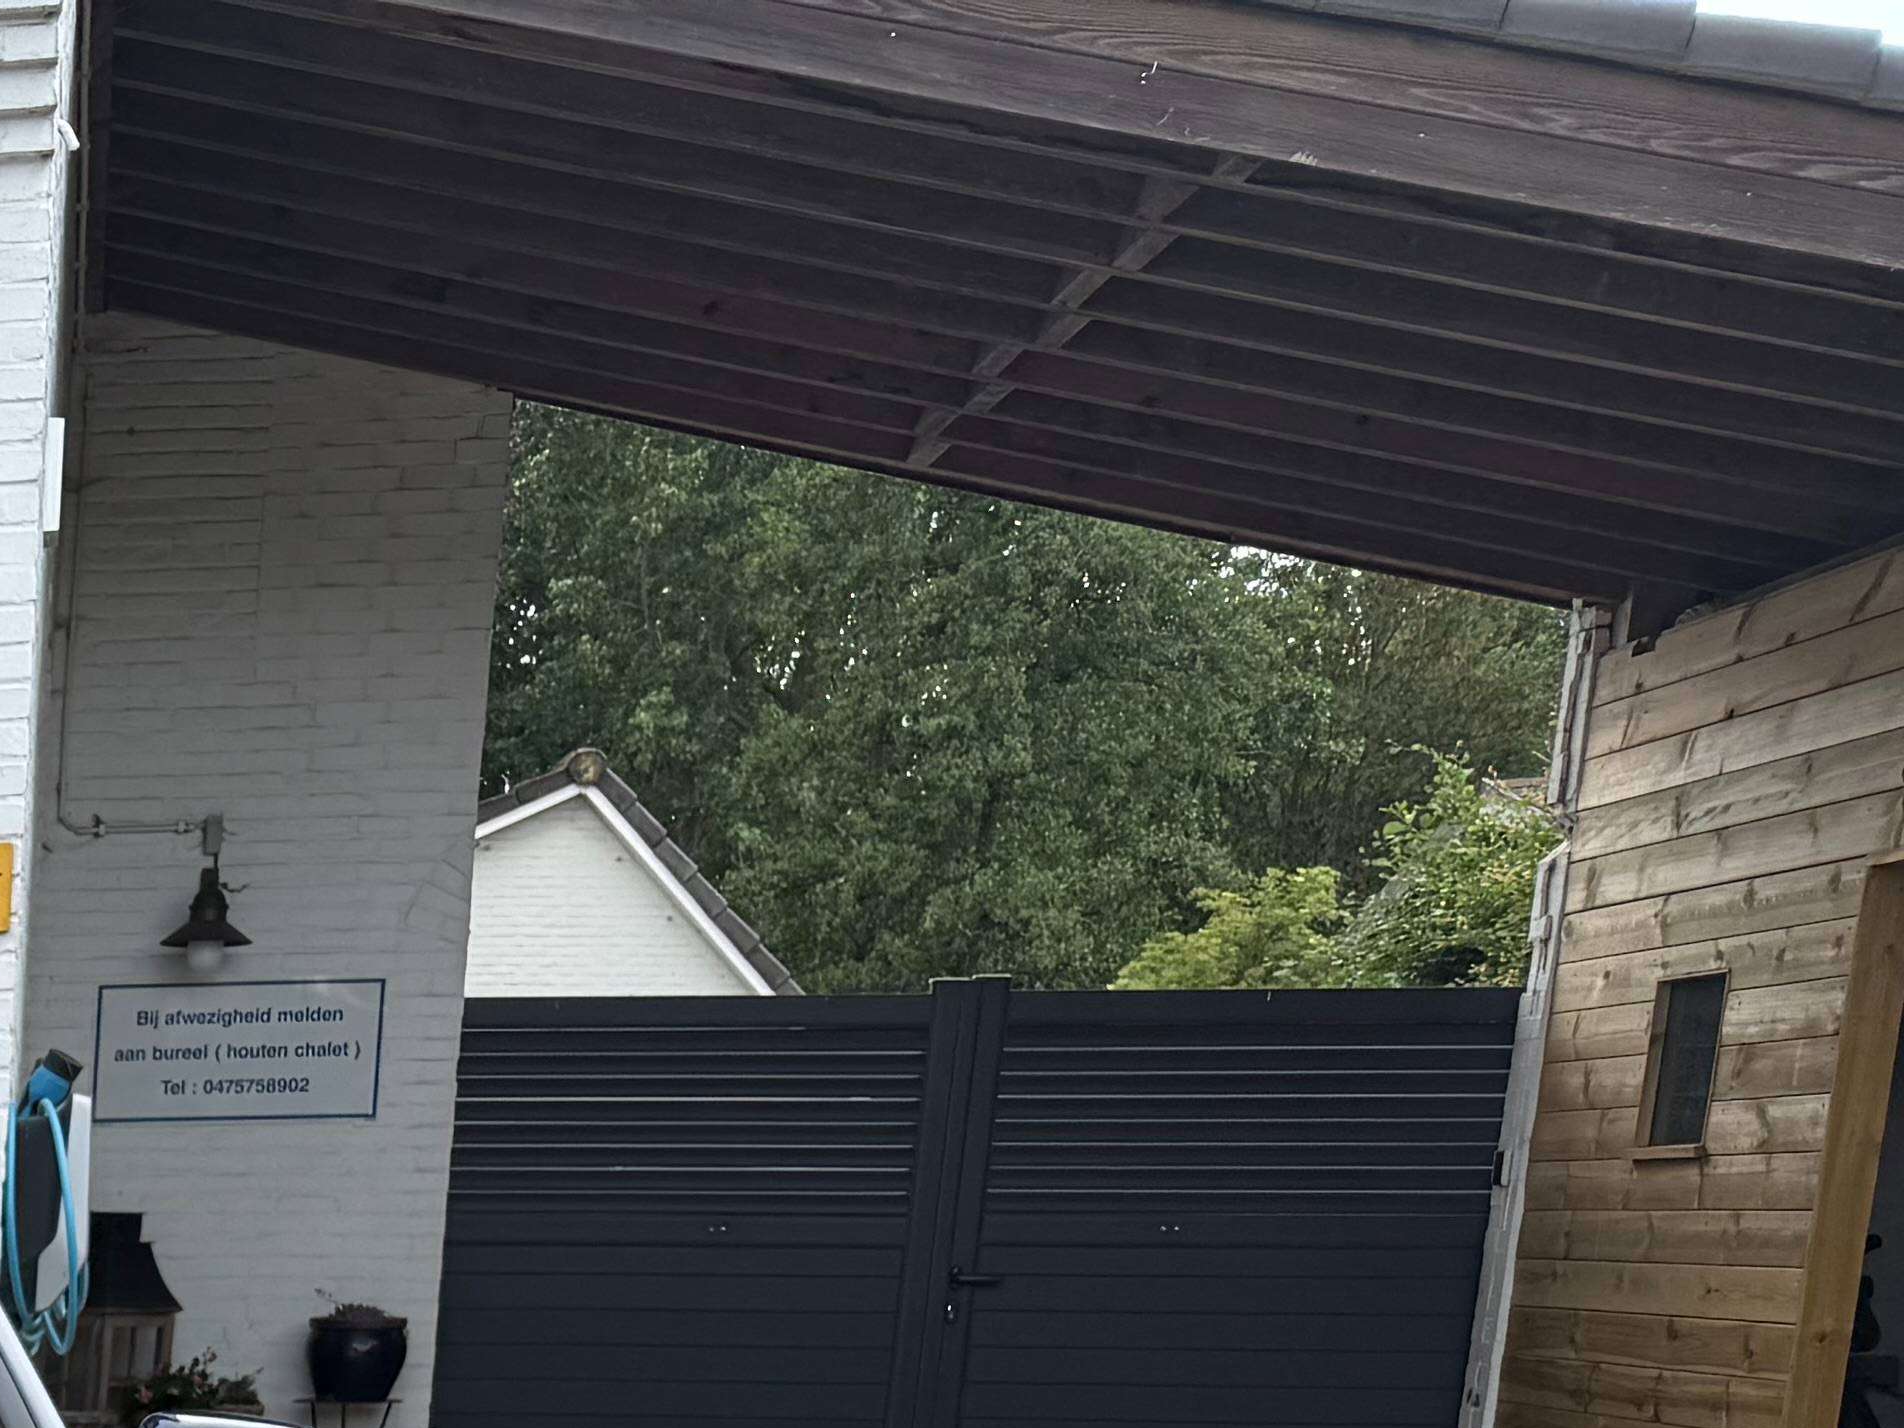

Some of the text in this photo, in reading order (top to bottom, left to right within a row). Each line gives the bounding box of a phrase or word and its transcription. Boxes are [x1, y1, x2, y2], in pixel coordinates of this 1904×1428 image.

[136, 1006, 344, 1029] Bij afwezigheid melden
[114, 1049, 146, 1062] aan
[152, 1044, 208, 1061] bureel
[226, 1043, 288, 1059] houten
[294, 1041, 348, 1058] chalet
[161, 1080, 186, 1095] Tel
[203, 1077, 310, 1095] 0475758902
